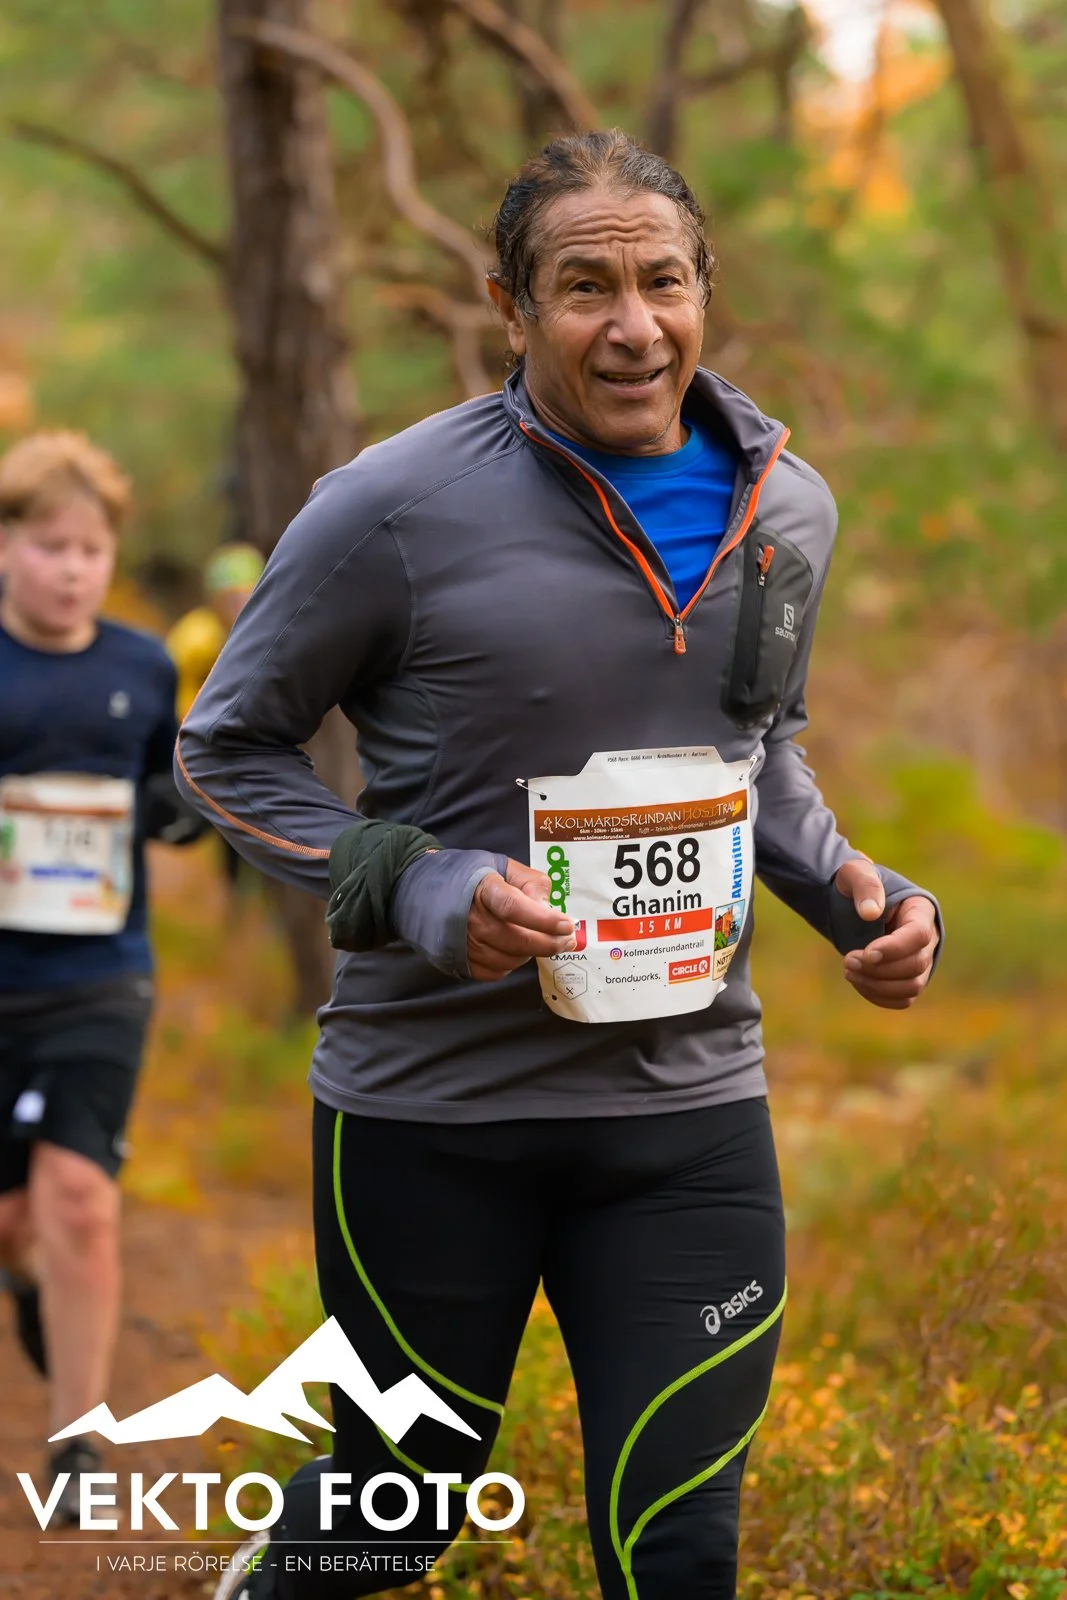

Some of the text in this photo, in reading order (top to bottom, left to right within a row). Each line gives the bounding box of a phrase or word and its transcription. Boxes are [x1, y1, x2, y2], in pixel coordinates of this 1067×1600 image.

[613, 837, 701, 889] 568
[732, 825, 743, 899] Aktivitus
[612, 889, 702, 917] Ghanim
[638, 917, 682, 934] 15 KM
[623, 939, 705, 958] kolmardsrundantrail
[672, 963, 697, 976] CIRCLE
[721, 1280, 763, 1319] asics
